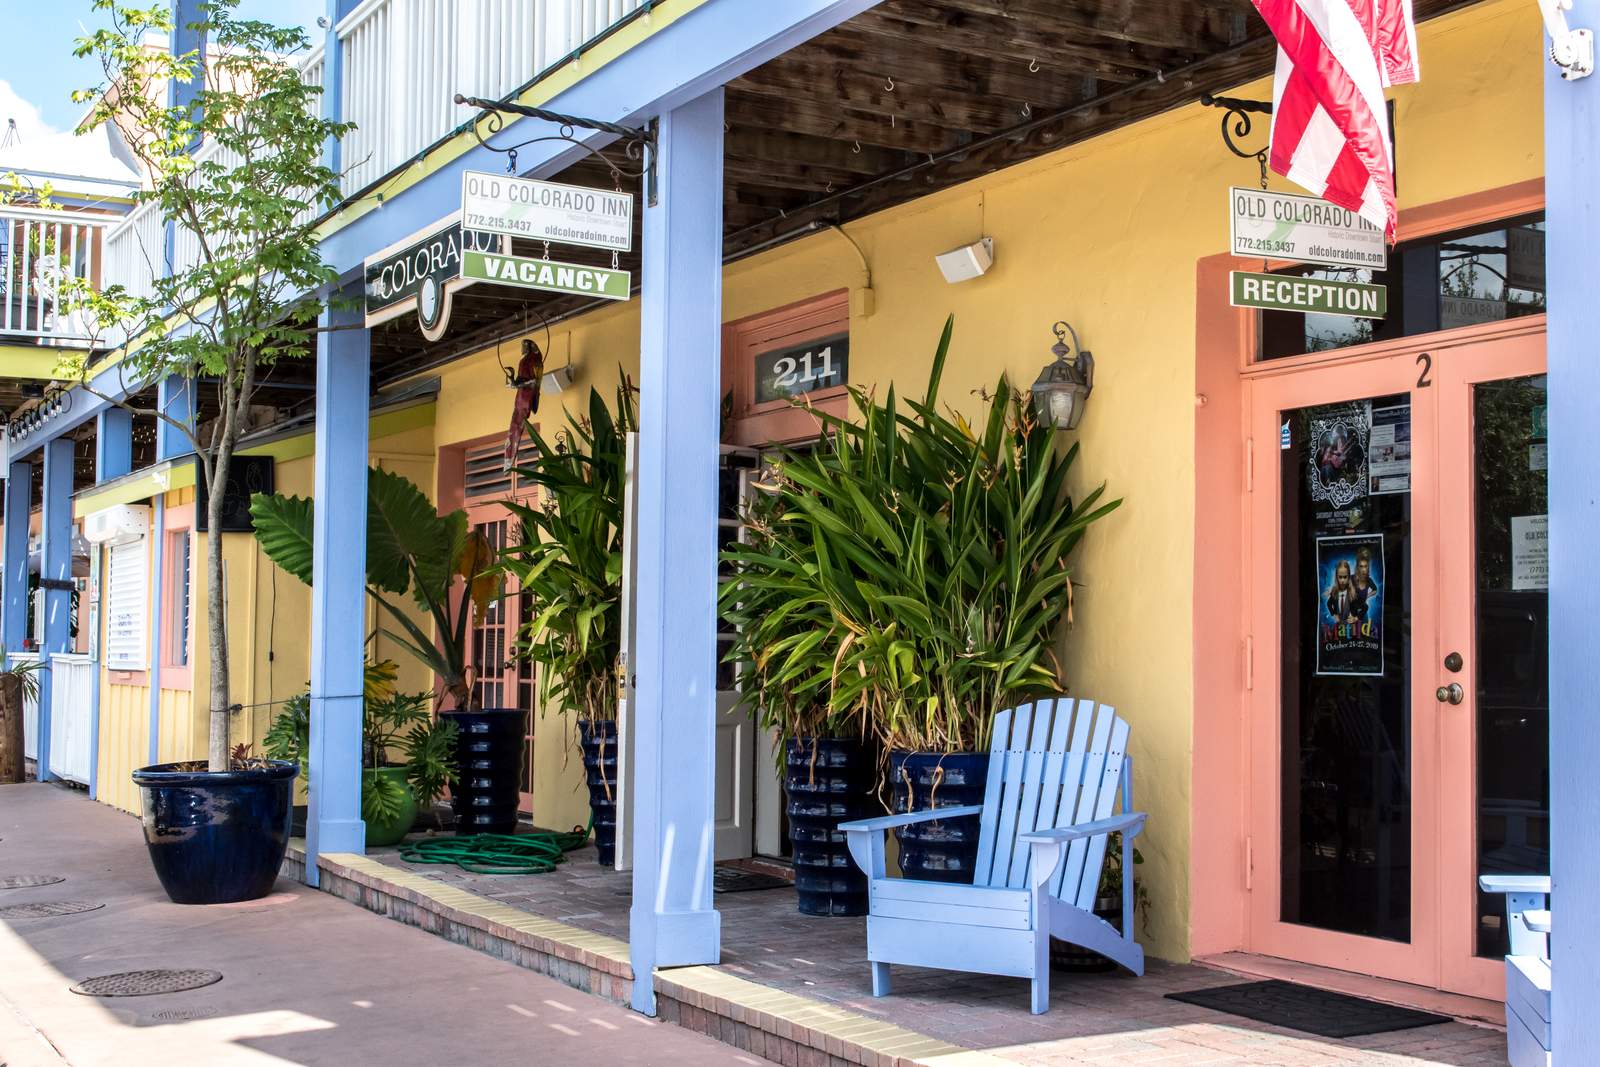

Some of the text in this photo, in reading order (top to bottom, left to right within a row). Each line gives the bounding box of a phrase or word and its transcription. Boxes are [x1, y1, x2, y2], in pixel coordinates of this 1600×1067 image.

[468, 177, 629, 218] OLD COLORADO INN
[1237, 195, 1267, 218] OLD
[1273, 199, 1352, 228] COLORADO
[467, 213, 532, 232] 772.215.3437
[544, 225, 628, 246] oldcoloradoinn.com
[1236, 236, 1296, 253] 772.215.3437
[1308, 244, 1384, 263] oldcoloradoinn.com
[483, 257, 611, 293] VACANCY
[1243, 277, 1378, 312] RECEPTION
[773, 346, 837, 389] 211
[1415, 352, 1432, 388] 2
[1321, 618, 1379, 642] Matilda
